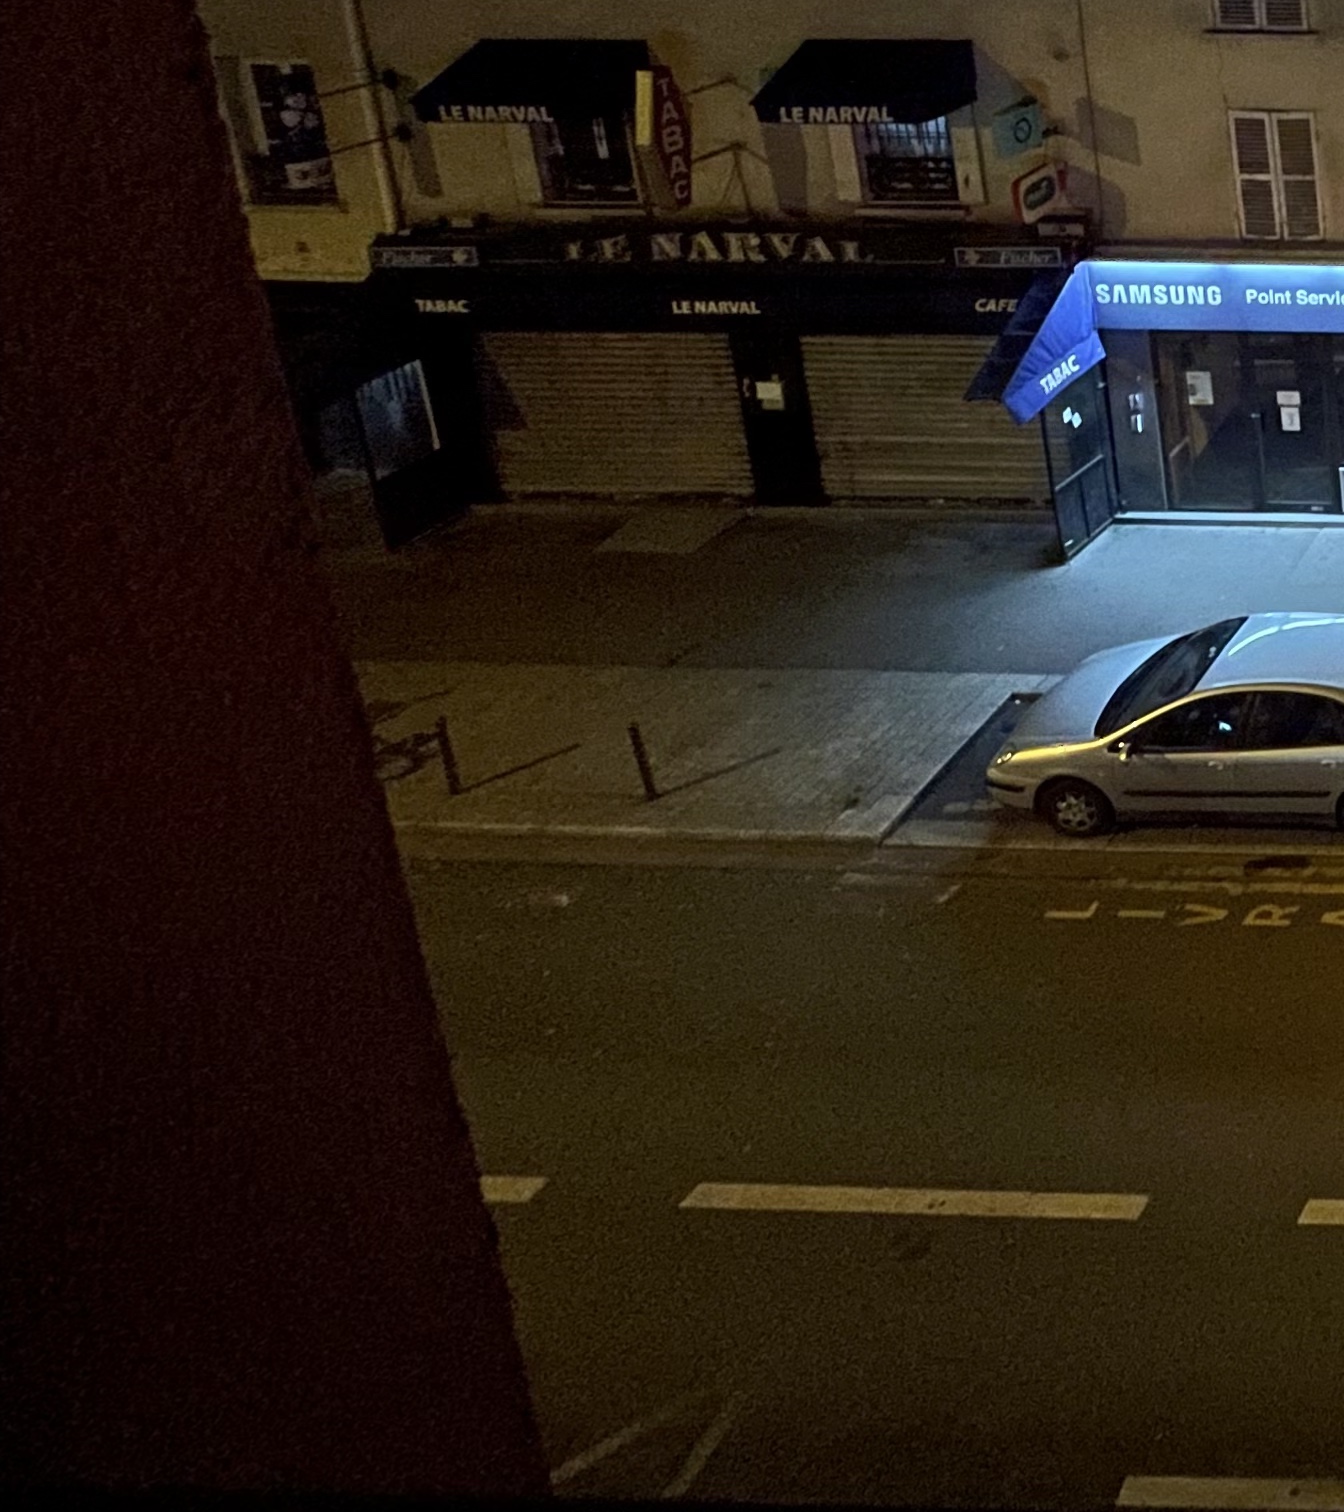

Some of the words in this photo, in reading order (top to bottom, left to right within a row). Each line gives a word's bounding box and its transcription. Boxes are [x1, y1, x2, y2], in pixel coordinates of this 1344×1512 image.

[437, 104, 464, 122] LE
[466, 104, 555, 123] NARVAL
[779, 106, 804, 124] LE
[808, 106, 895, 124] NARVAL
[655, 76, 689, 201] TABAC
[564, 235, 633, 263] LE
[650, 230, 870, 264] NARVAL
[1095, 283, 1222, 307] SAMSUNG
[1245, 288, 1293, 306] Point
[414, 298, 471, 314] TABAC
[672, 299, 692, 315] LE
[693, 299, 762, 315] NARVAL
[1039, 354, 1080, 396] TABAC
